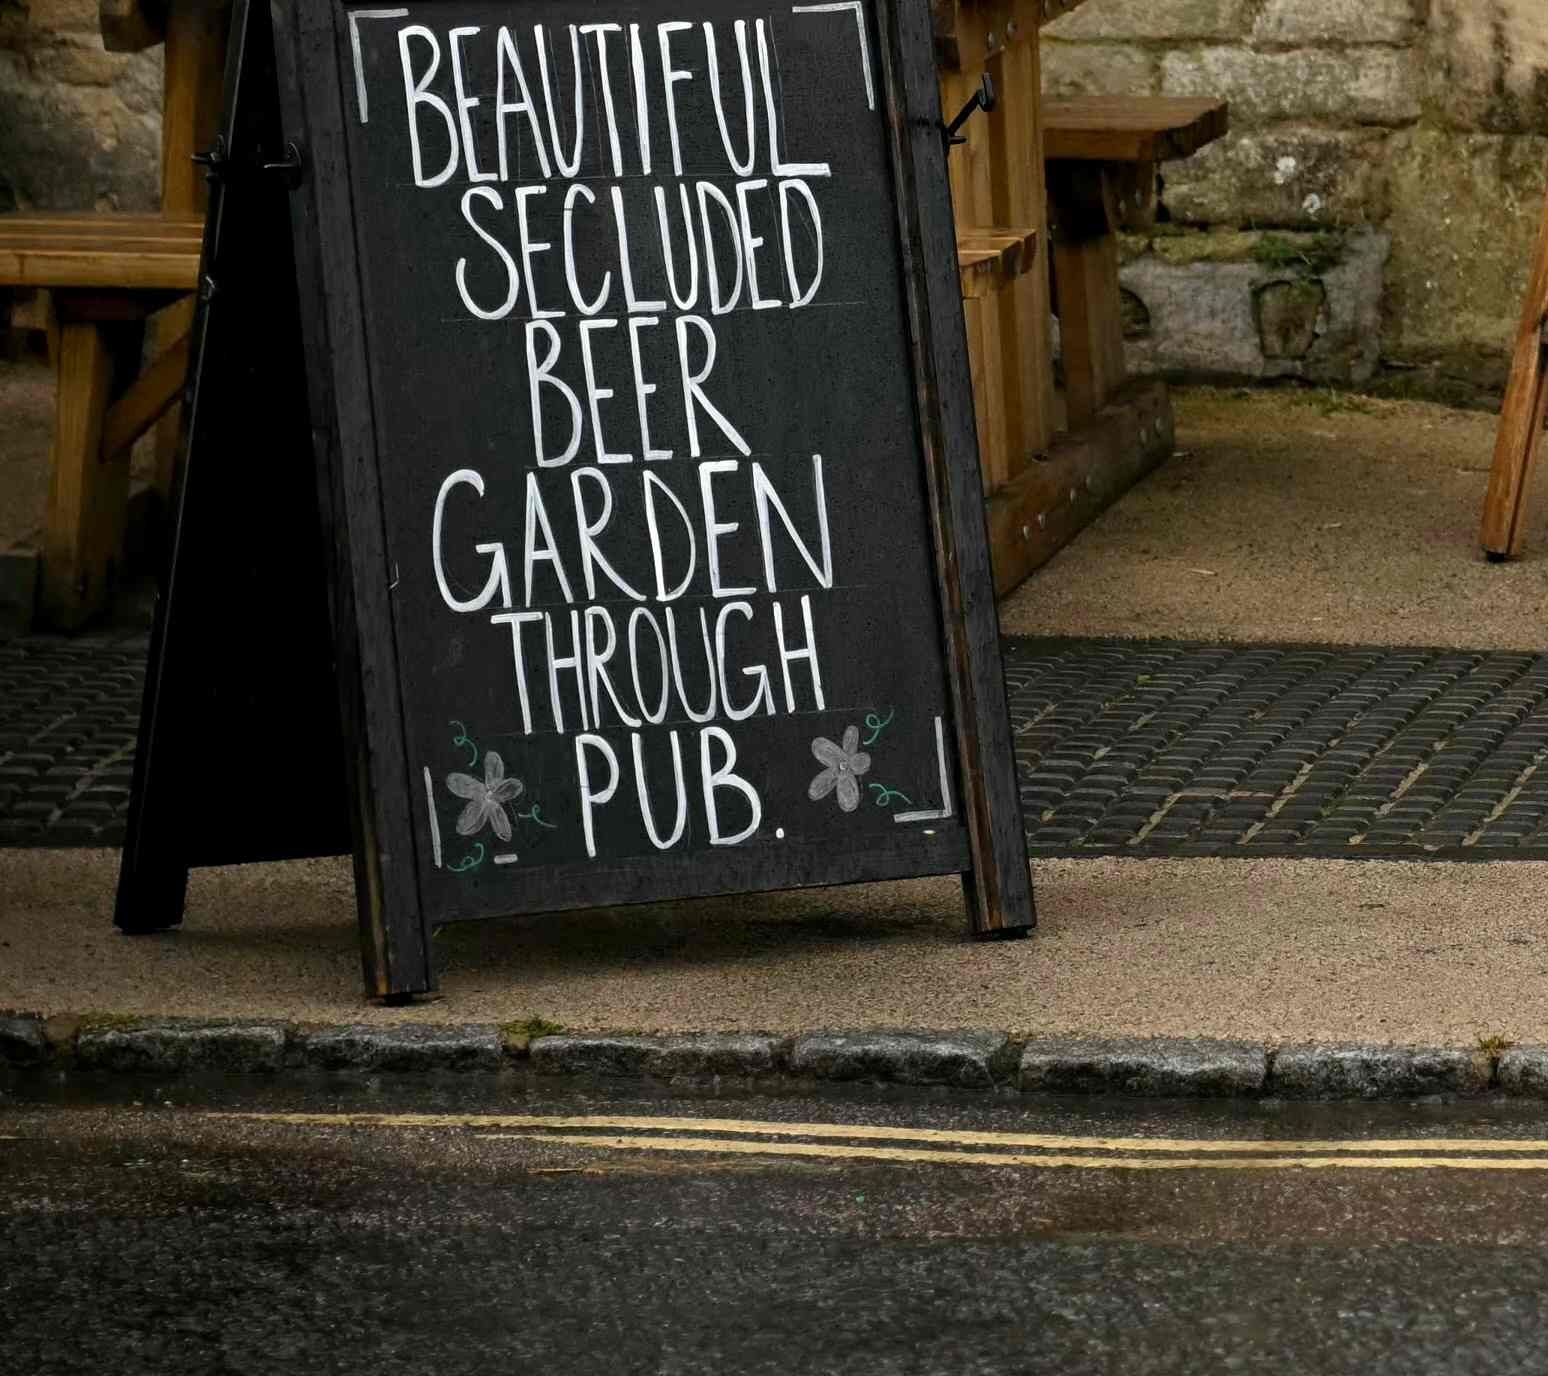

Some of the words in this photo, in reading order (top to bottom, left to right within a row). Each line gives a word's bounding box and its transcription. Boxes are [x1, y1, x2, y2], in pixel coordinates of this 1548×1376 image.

[399, 20, 831, 188] BEAUTIFUL
[456, 179, 823, 320] SECLUDED
[523, 316, 751, 467] BEER
[432, 454, 832, 612] GARDEN
[491, 596, 826, 734] THROUGH
[576, 727, 785, 857] PUB.
